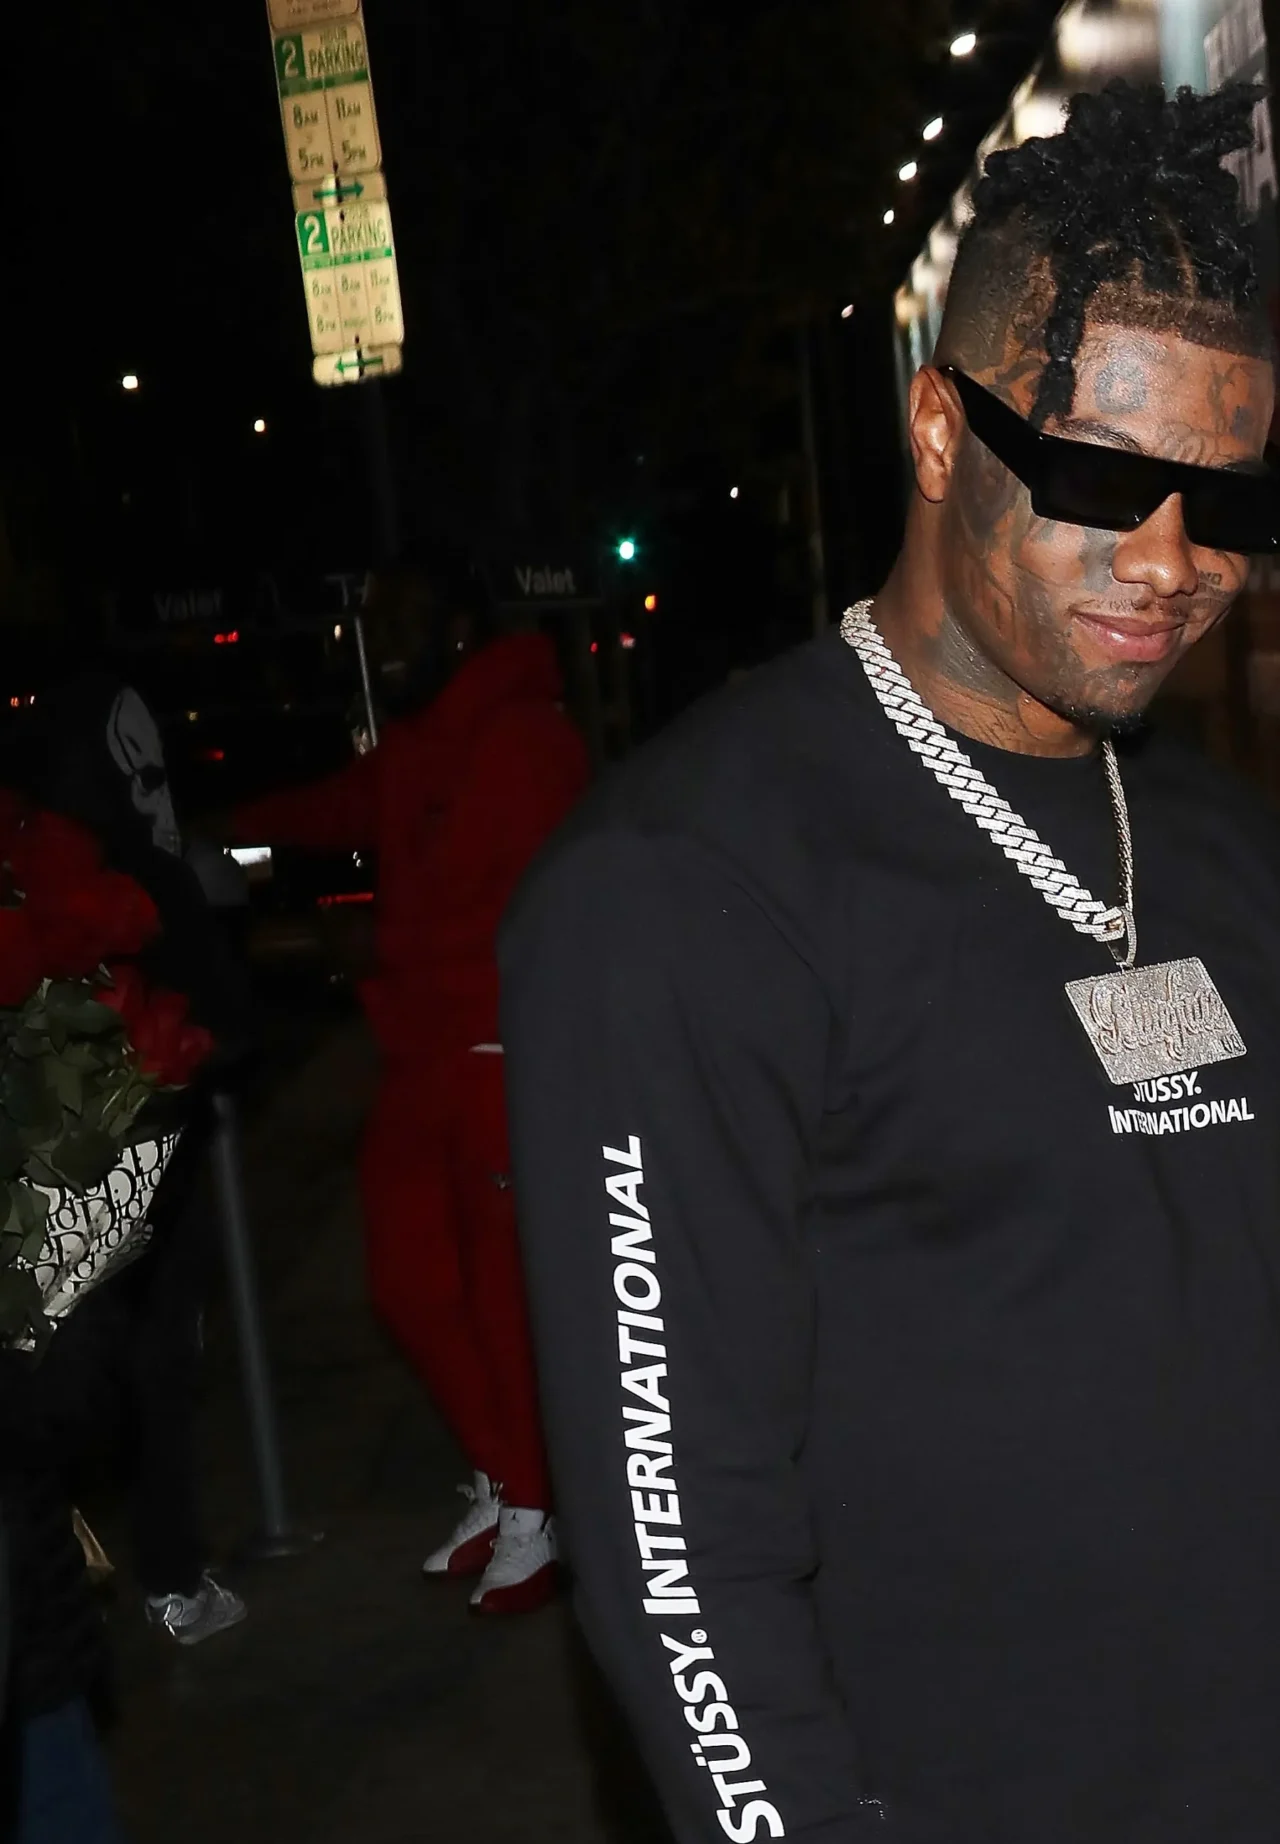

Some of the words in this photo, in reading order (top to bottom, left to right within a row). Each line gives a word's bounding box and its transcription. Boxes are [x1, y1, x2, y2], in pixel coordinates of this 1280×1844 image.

[281, 39, 299, 78] 2
[309, 41, 365, 77] PARKING
[304, 215, 324, 253] 2
[331, 218, 388, 254] PARKING
[513, 565, 577, 597] Valet
[1107, 1097, 1255, 1136] INTERNATIONAL
[602, 1134, 701, 1614] INTERNATIONAL
